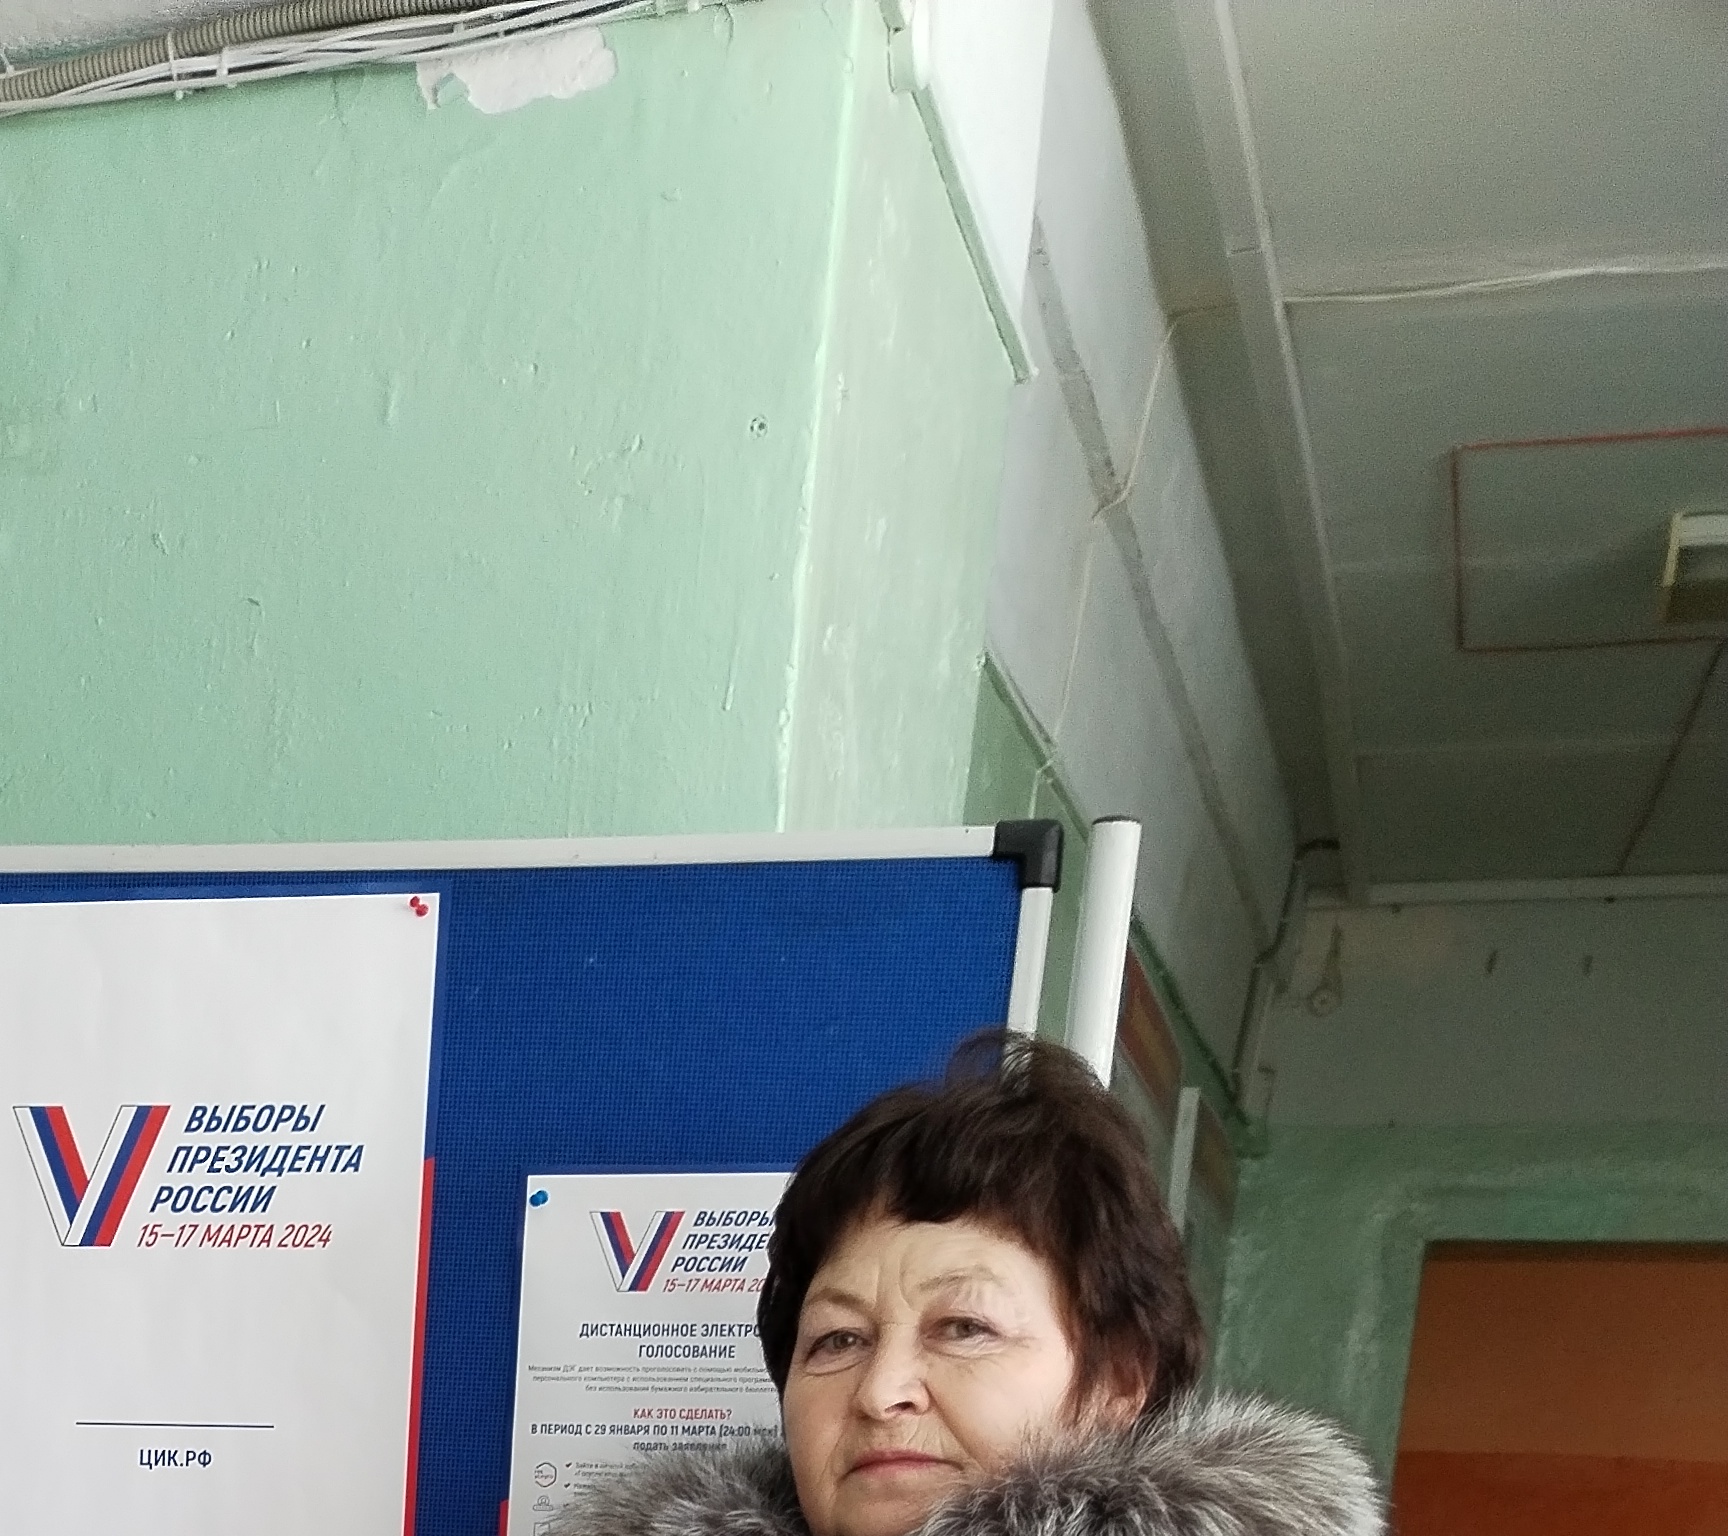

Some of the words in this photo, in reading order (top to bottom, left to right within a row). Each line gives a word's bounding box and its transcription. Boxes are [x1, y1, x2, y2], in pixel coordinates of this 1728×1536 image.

[183, 1104, 326, 1133] ВЫБОРЫ
[166, 1145, 365, 1177] ПРЕЗИДЕНТА
[149, 1185, 277, 1213] РОССИИ
[198, 1224, 275, 1248] МАРТА
[276, 1224, 333, 1248] 2024
[682, 1233, 770, 1252] ПРЕЗИДЕ
[671, 1256, 748, 1272] РОССИИ
[700, 1278, 746, 1292] МАРТА
[579, 1323, 698, 1338] ДИСТАНЦИОННОЕ
[638, 1344, 736, 1359] ГОЛОСОВАНИЕ
[633, 1408, 654, 1419] КАК
[656, 1408, 677, 1420] ЭТО
[679, 1408, 732, 1421] СДЕЛАТЬ?
[540, 1423, 583, 1436] ПЕРИОД
[594, 1424, 607, 1435] 29
[608, 1424, 650, 1436] ЯНВАРЯ
[652, 1424, 668, 1436] ПО
[670, 1425, 679, 1436] 11
[681, 1424, 717, 1437] МАРТА
[139, 1449, 212, 1470] ЦИК.РФ
